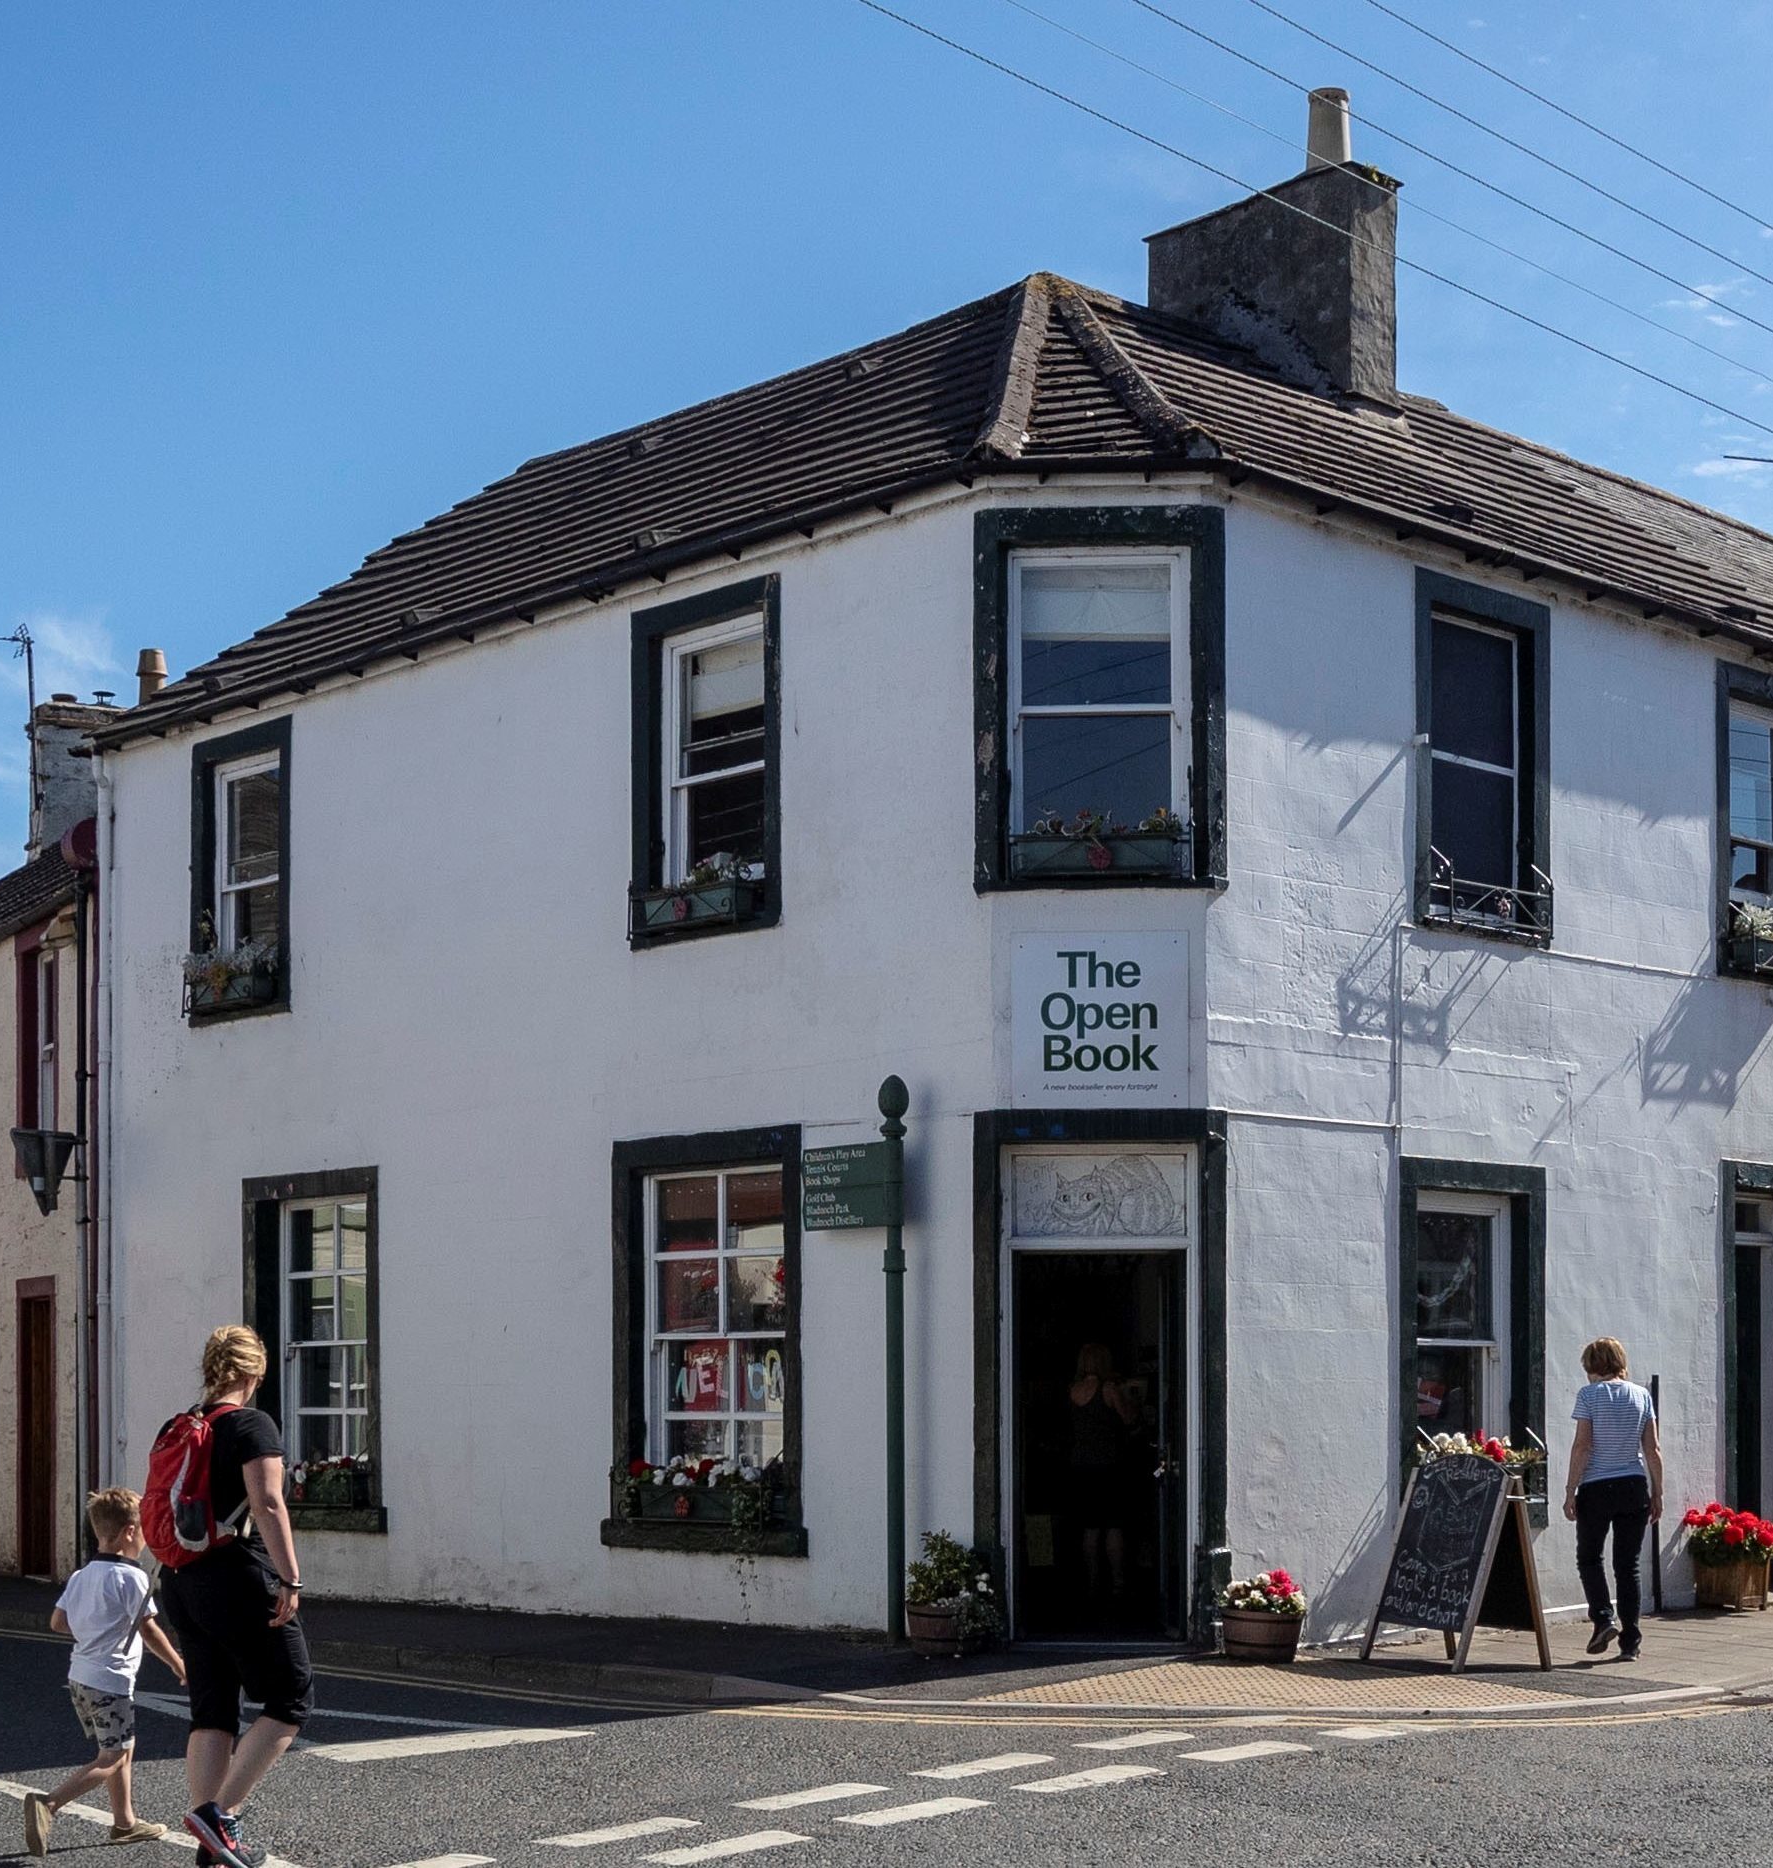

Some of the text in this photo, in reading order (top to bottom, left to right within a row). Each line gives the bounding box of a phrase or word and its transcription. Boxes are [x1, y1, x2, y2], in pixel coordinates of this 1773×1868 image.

[1057, 951, 1141, 988] The
[1040, 992, 1158, 1039] Open
[1043, 1034, 1160, 1072] Book
[1043, 1083, 1050, 1091] A
[1067, 1083, 1104, 1091] bookseller
[1127, 1083, 1159, 1092] fortnight
[804, 1149, 866, 1162] Children's Play Area
[805, 1162, 849, 1175] Tennis Courts
[805, 1175, 841, 1187] Book Shops
[806, 1192, 836, 1203] Golf Club
[835, 1203, 850, 1214] Park
[1427, 1586, 1437, 1599] a
[1440, 1582, 1471, 1607] book
